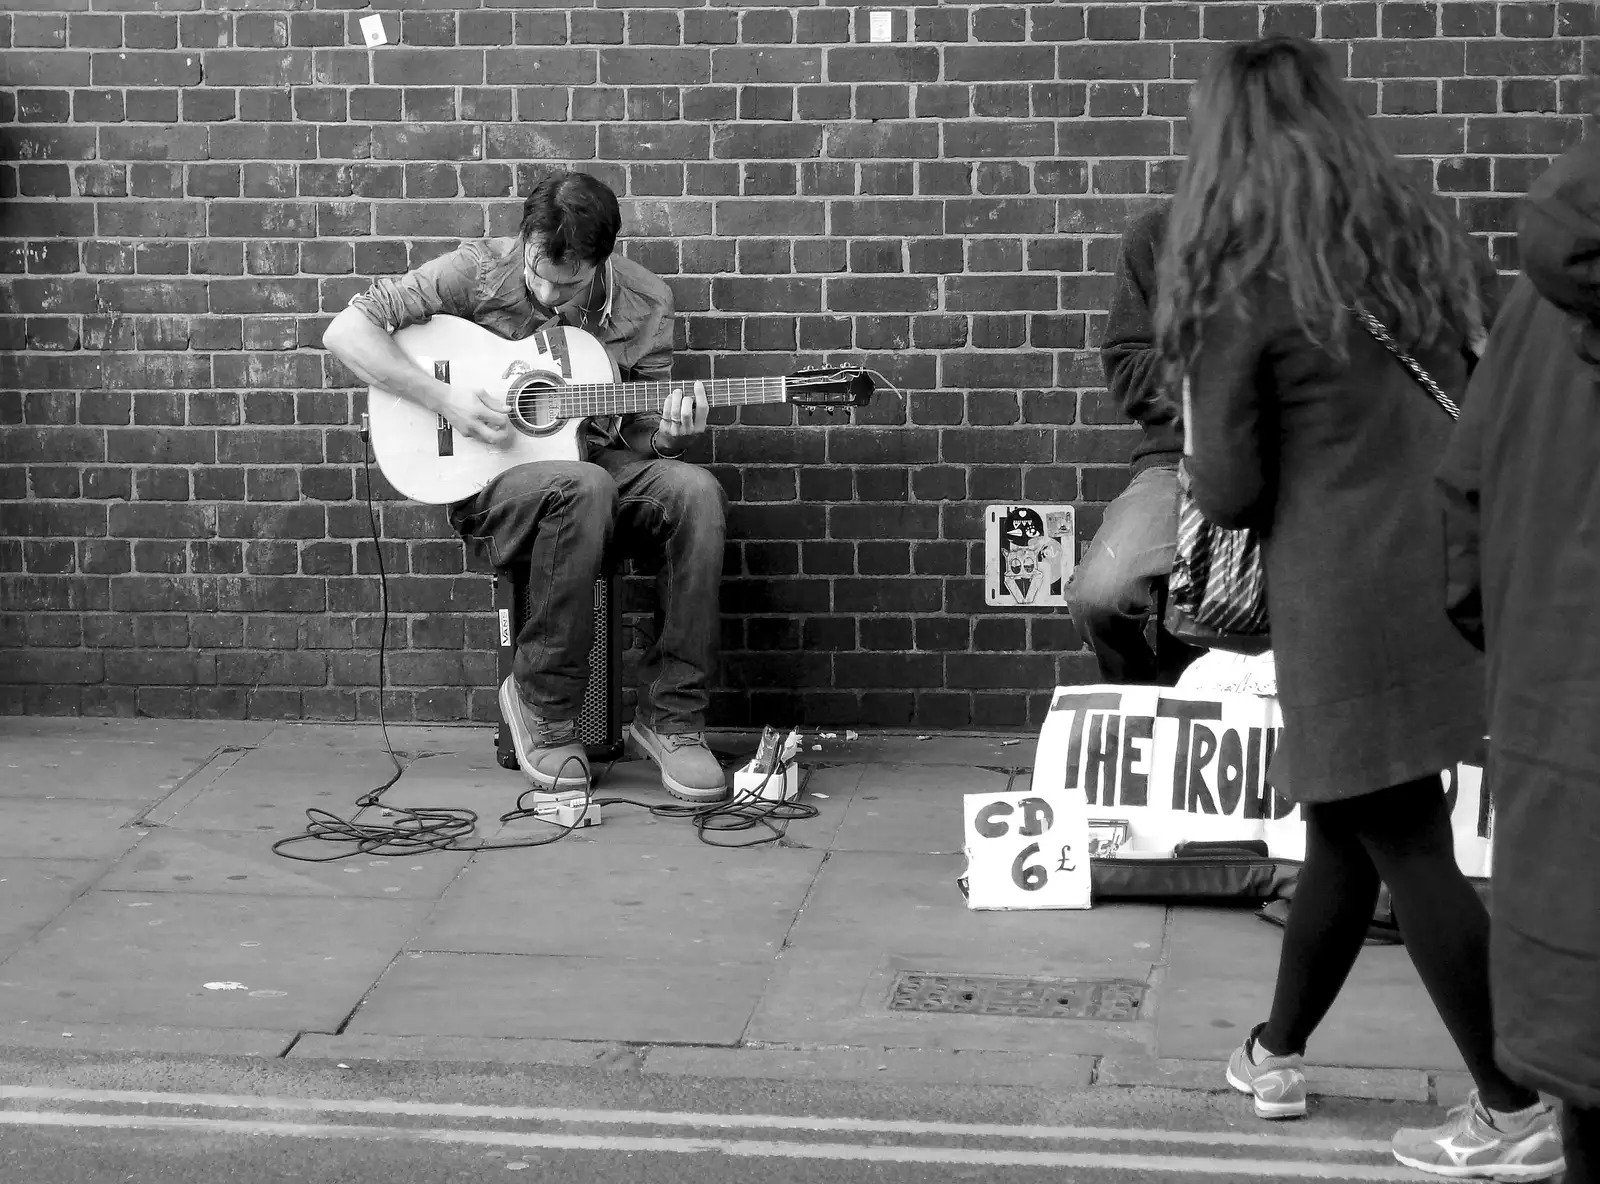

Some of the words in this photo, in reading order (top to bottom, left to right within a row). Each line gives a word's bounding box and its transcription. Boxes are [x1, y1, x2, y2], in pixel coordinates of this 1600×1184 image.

[1051, 692, 1155, 807] THE
[974, 797, 1054, 838] CD
[1011, 842, 1048, 891] 6
[1055, 845, 1076, 872] £
